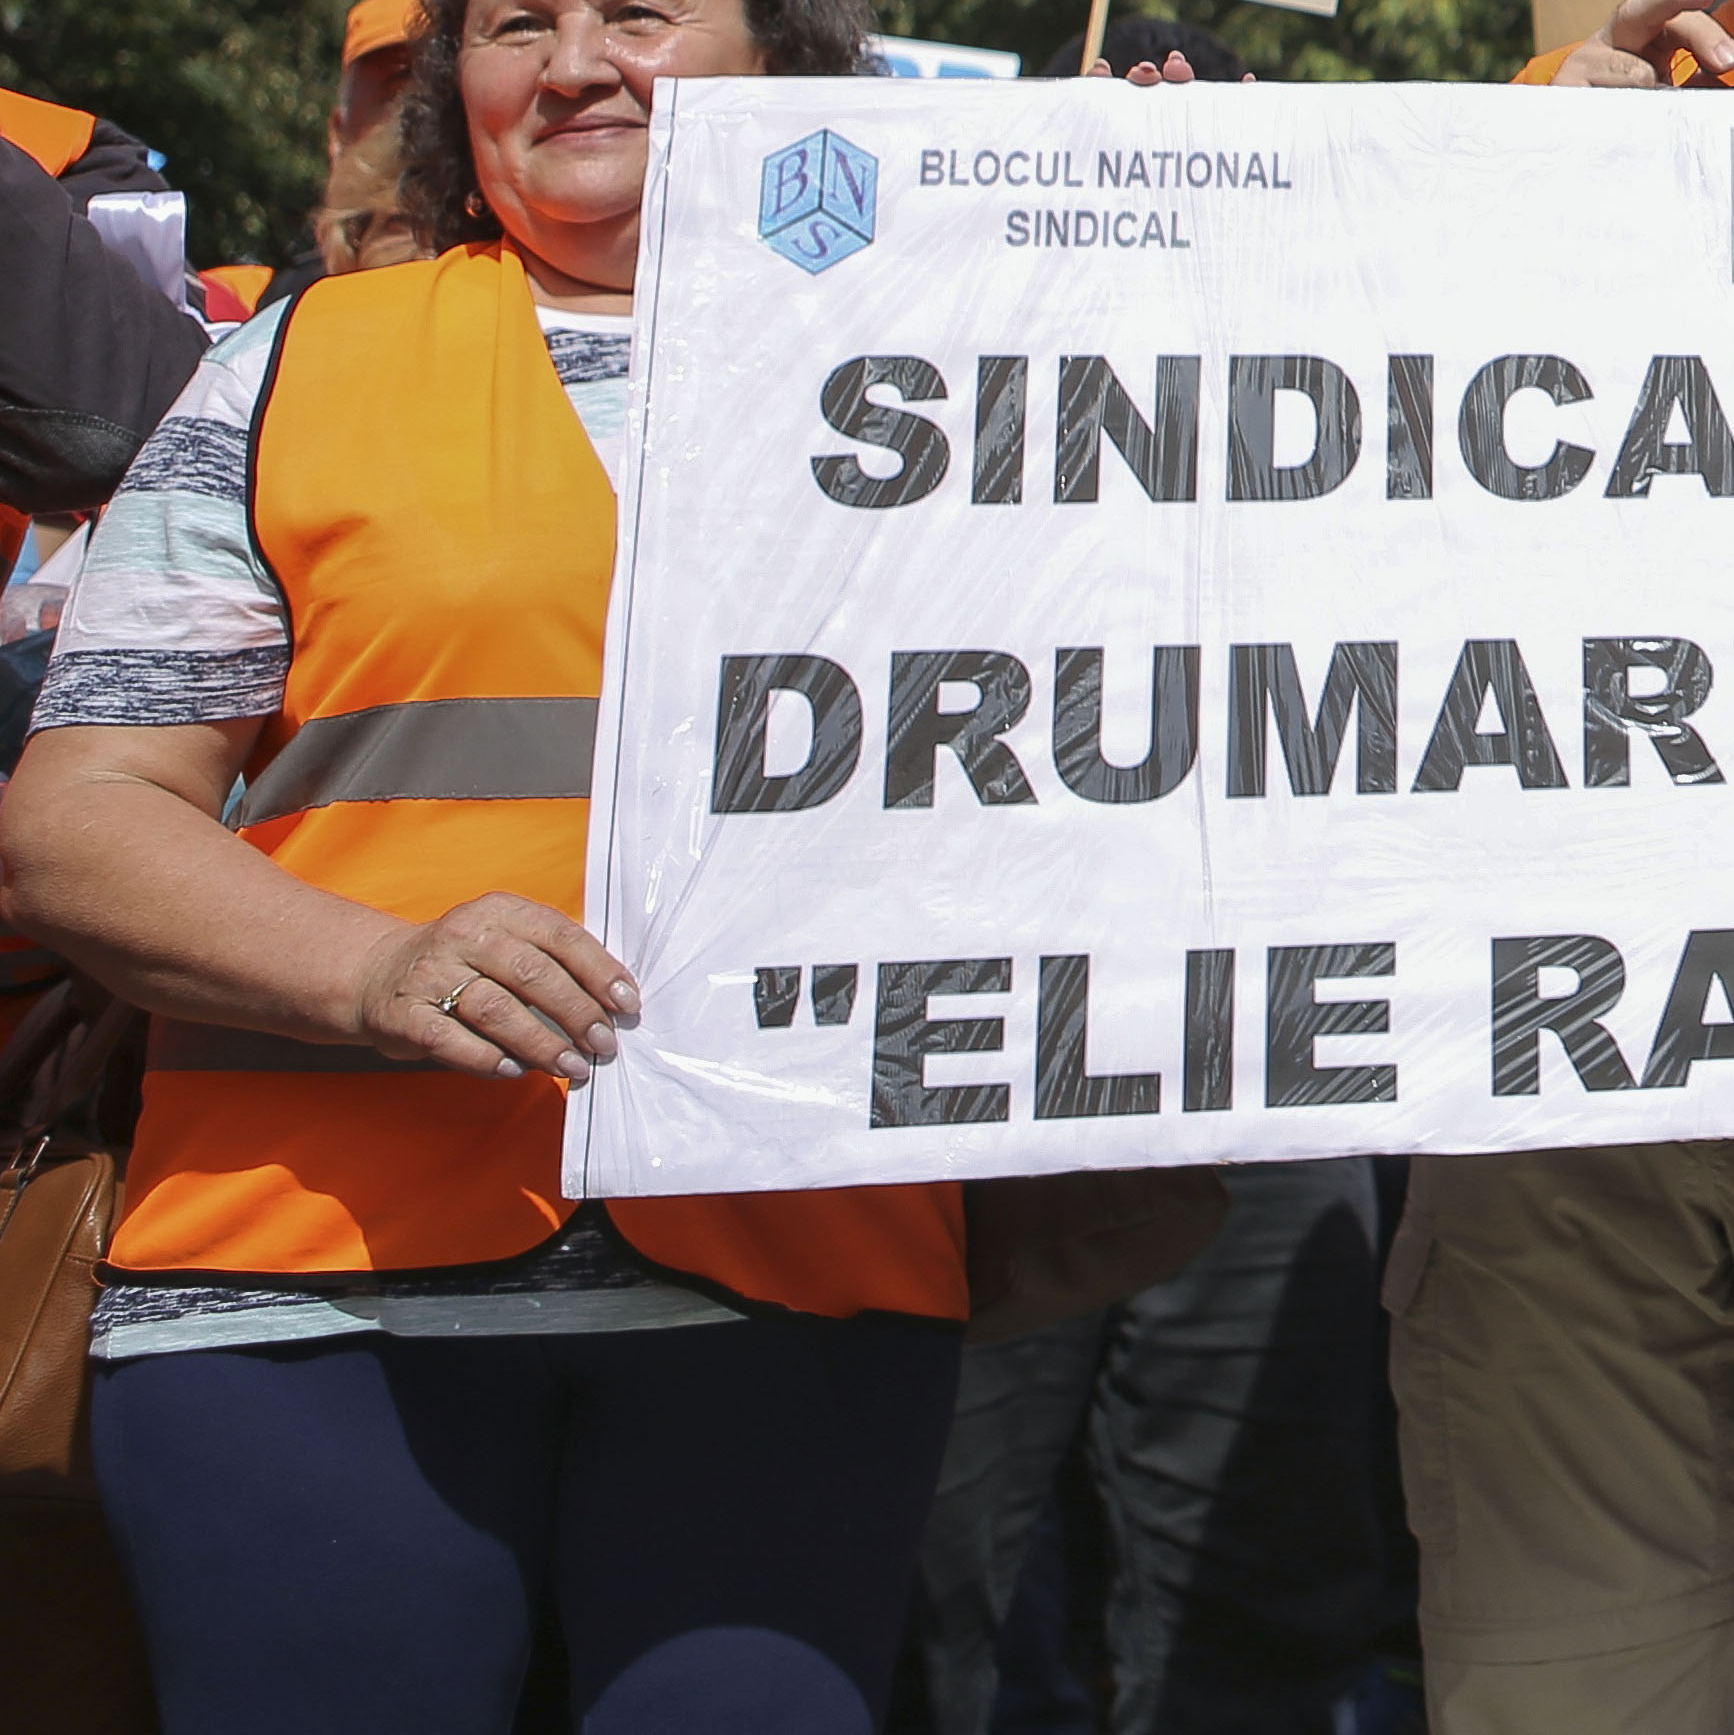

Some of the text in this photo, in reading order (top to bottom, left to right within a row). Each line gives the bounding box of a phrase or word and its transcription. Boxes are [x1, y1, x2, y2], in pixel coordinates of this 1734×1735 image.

[918, 148, 1293, 190] BLOCUL NATIONAL
[1004, 209, 1191, 249] SINDICAL
[752, 941, 1399, 1130] "ELIE
